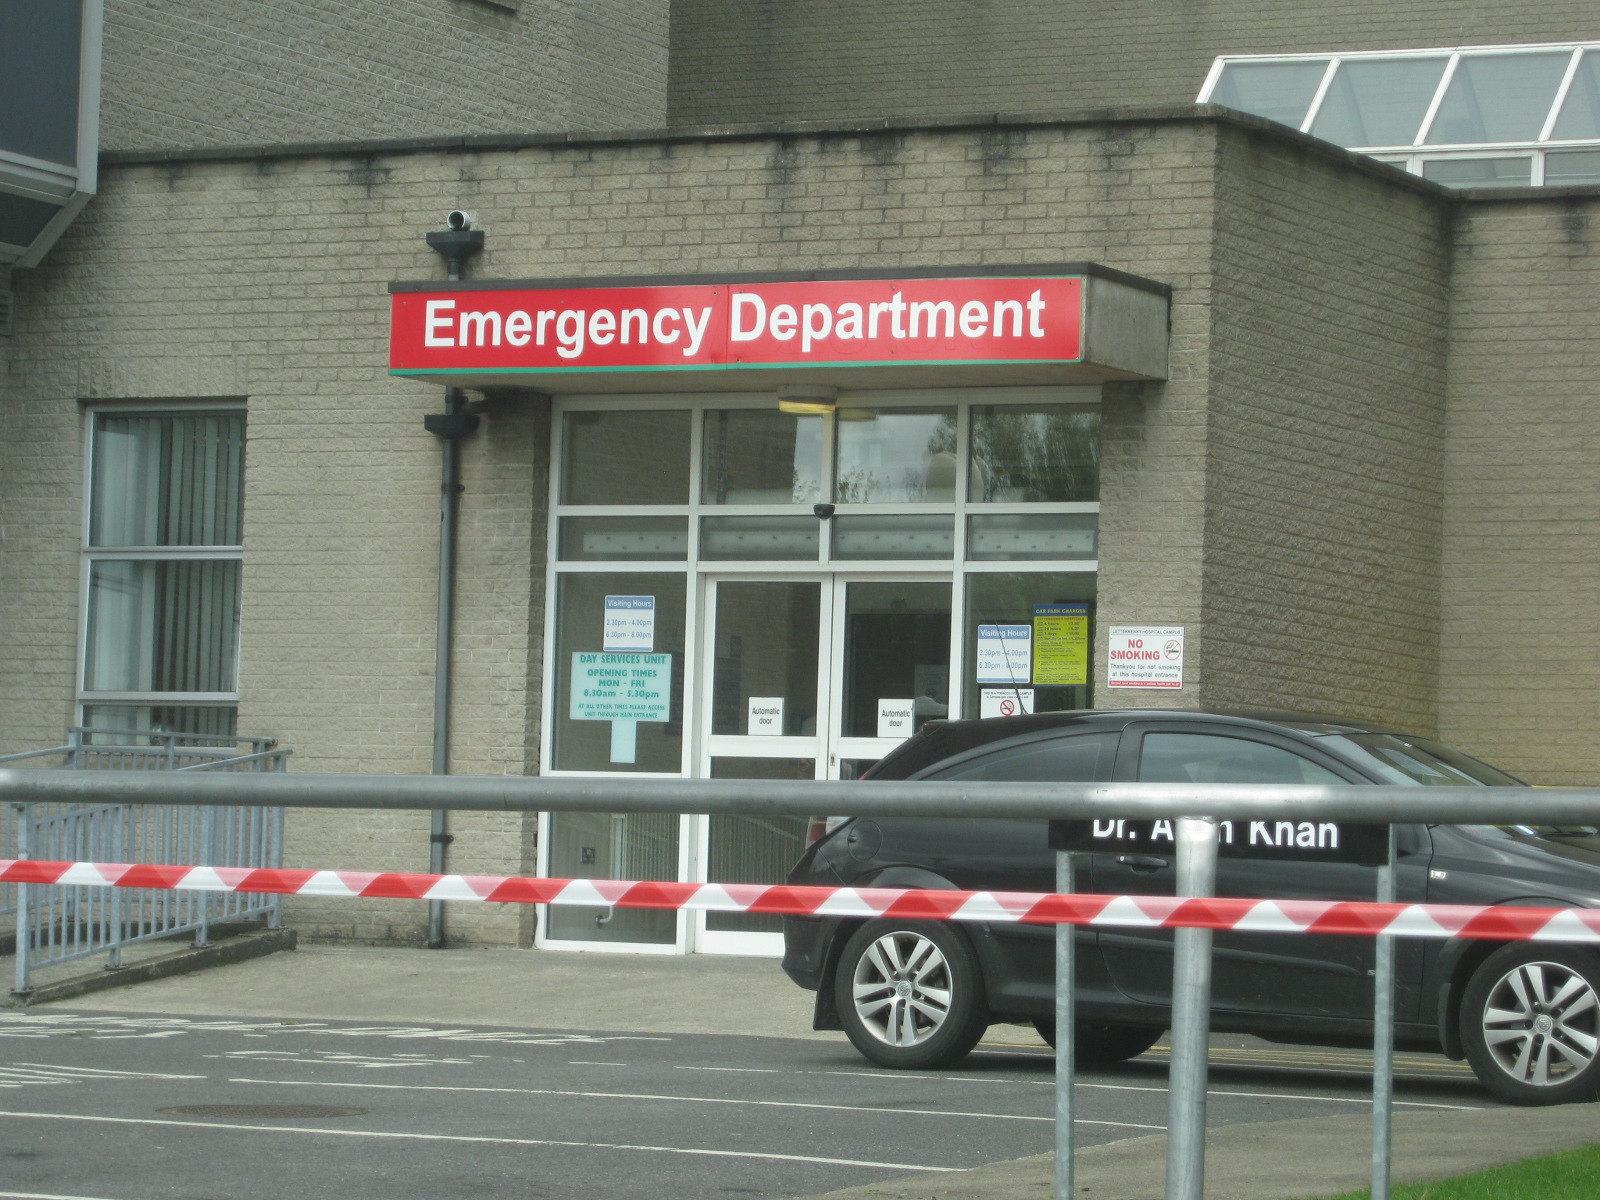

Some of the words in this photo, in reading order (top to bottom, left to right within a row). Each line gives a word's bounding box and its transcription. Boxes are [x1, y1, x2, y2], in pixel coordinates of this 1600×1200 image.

[424, 298, 712, 359] Emergency
[730, 288, 1046, 353] Department
[607, 599, 632, 608] Visiting
[632, 599, 652, 607] Hours
[606, 618, 627, 627] 2.30pm
[631, 618, 652, 627] 4.00pm
[605, 631, 627, 639] 6.30pm
[630, 631, 652, 639] 8.00pm
[981, 629, 1006, 637] Visiting
[1007, 629, 1028, 637] Hours
[1127, 639, 1144, 649] NO
[979, 649, 1001, 657] 2.30pm
[1006, 649, 1028, 657] 4.00pm
[1110, 650, 1161, 661] SMOKING
[580, 654, 597, 663] DAY
[601, 654, 641, 664] SERVICES
[644, 655, 667, 664] UNIT
[1110, 663, 1136, 671] Thankyou
[1158, 664, 1181, 672] smoking
[587, 668, 628, 677] OPENING
[631, 669, 658, 677] TIMES
[598, 679, 620, 687] MON
[630, 679, 646, 687] FRI
[583, 688, 617, 697] 8.30am
[627, 689, 660, 699] 5.30pm
[752, 707, 780, 715] Automatic
[881, 709, 911, 718] Automatic
[758, 717, 773, 725] door
[888, 719, 903, 728] door
[1093, 819, 1136, 839] Dr.
